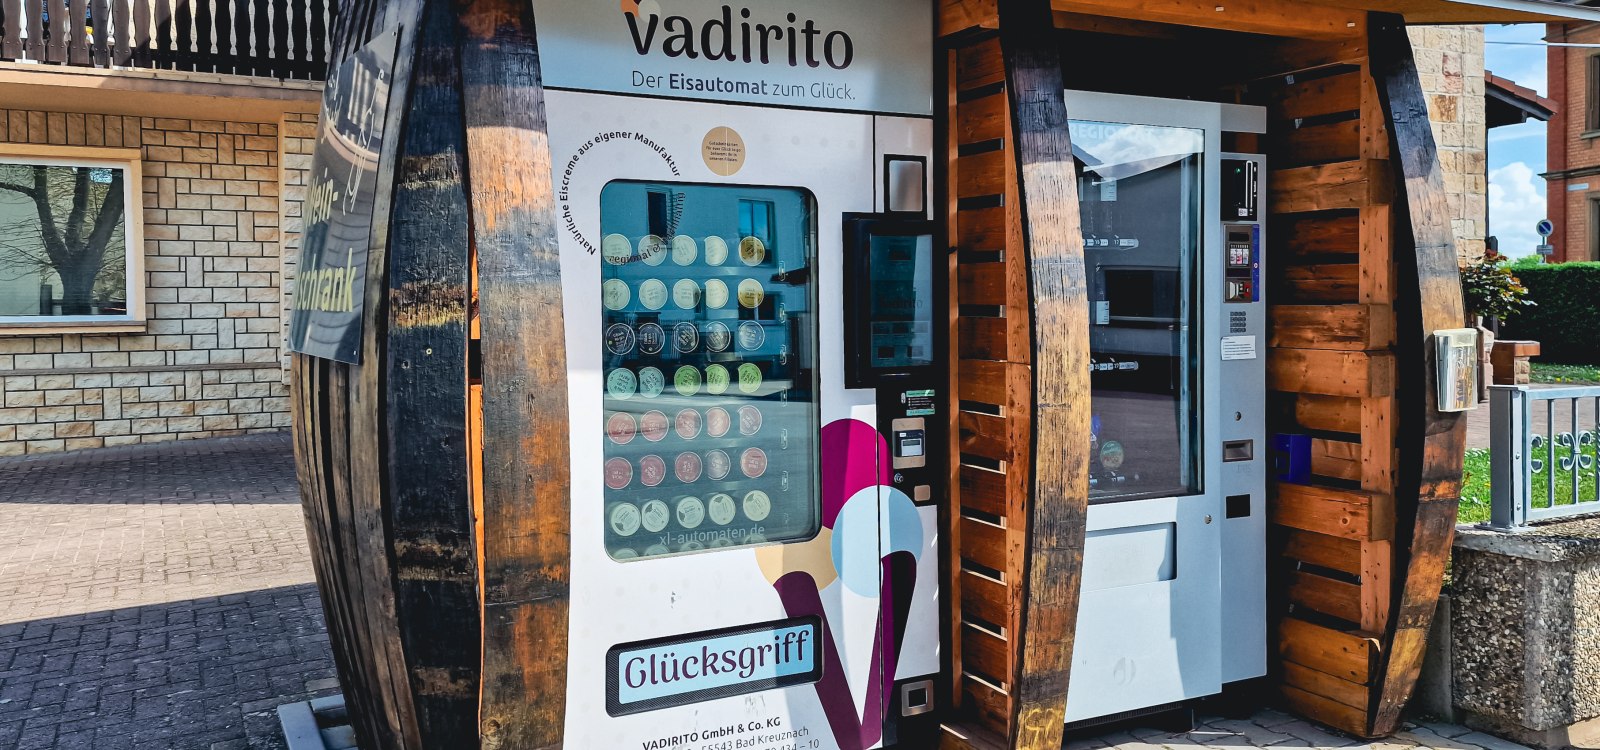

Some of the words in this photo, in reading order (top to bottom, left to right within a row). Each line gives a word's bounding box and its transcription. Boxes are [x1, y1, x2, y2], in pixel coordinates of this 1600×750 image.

[623, 5, 854, 70] vadirito
[632, 71, 664, 89] Der
[669, 73, 768, 96] Eisautomat
[772, 83, 805, 98] zum
[810, 82, 857, 100] Glück.
[578, 140, 594, 156] aus
[594, 131, 632, 143] eigener
[634, 132, 681, 177] Manufaktur
[559, 154, 580, 201] Eiscreme
[562, 204, 597, 255] Natürliche
[609, 248, 651, 266] regional
[659, 523, 765, 546] xl-automatende
[624, 629, 810, 690] Glücksgriff
[642, 732, 699, 750] VADIRITO
[701, 726, 735, 740] GmbH
[737, 723, 745, 734] &
[748, 721, 764, 731] Co.
[766, 717, 781, 728] KG
[736, 736, 756, 749] Bad
[757, 726, 809, 745] Kreuznach
[808, 738, 820, 749] 10
